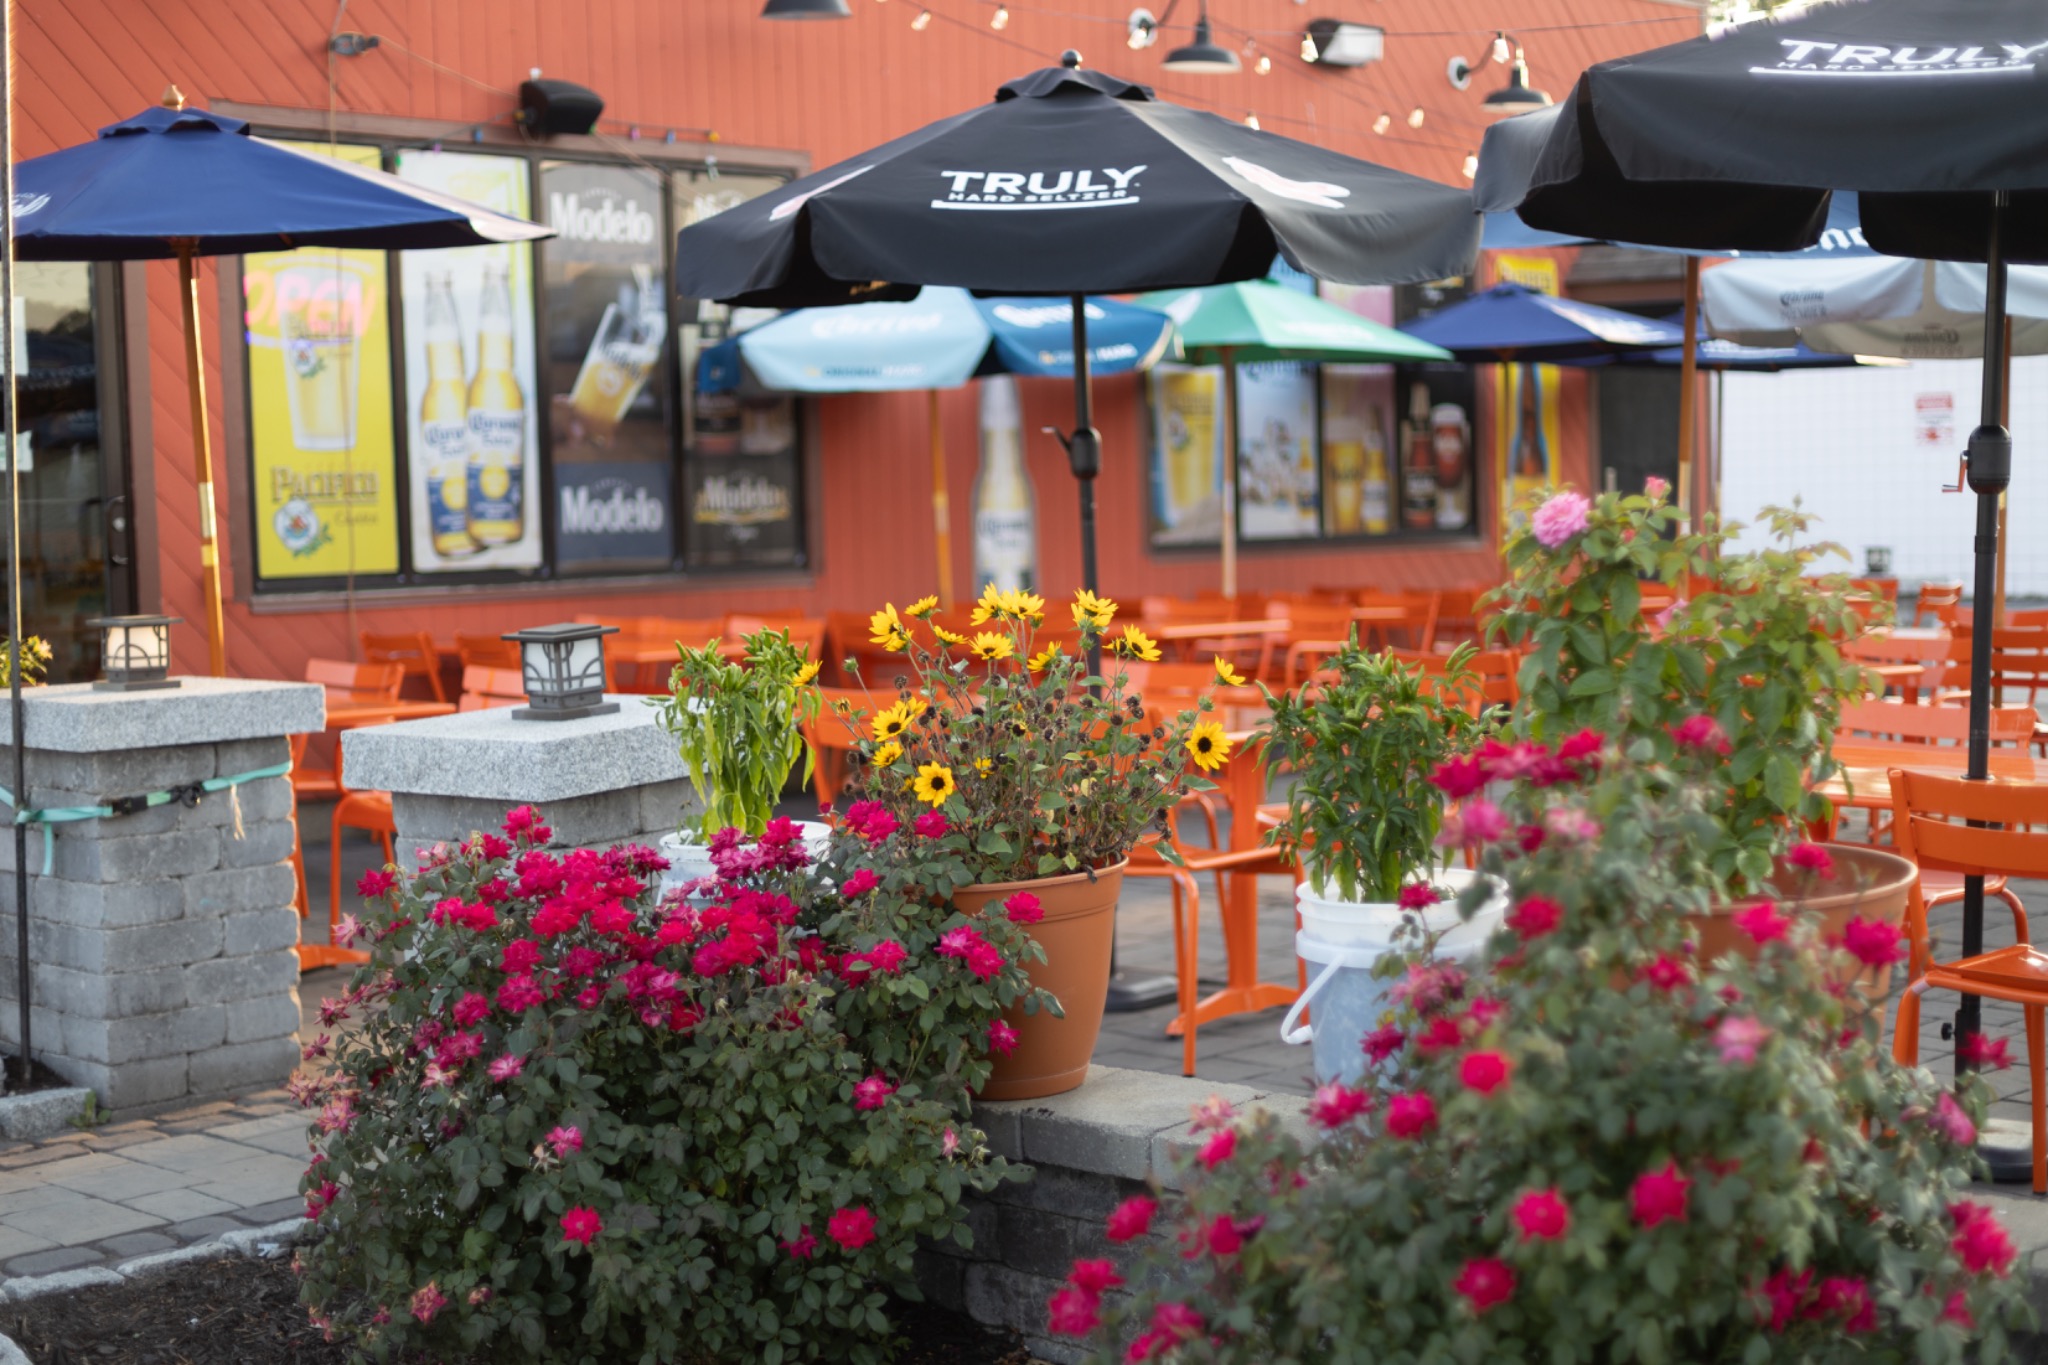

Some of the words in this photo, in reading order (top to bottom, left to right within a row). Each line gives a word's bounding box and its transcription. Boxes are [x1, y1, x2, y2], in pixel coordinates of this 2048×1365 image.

[1777, 61, 1866, 71] HARD
[1881, 60, 2021, 71] SELTZER
[1780, 38, 2048, 65] TRULY
[940, 164, 1148, 196] TRULY
[948, 191, 1016, 203] HARD
[1024, 189, 1128, 203] SELTZER
[550, 191, 654, 244] Modelo
[243, 269, 378, 339] OPEN
[560, 484, 664, 534] Modelo
